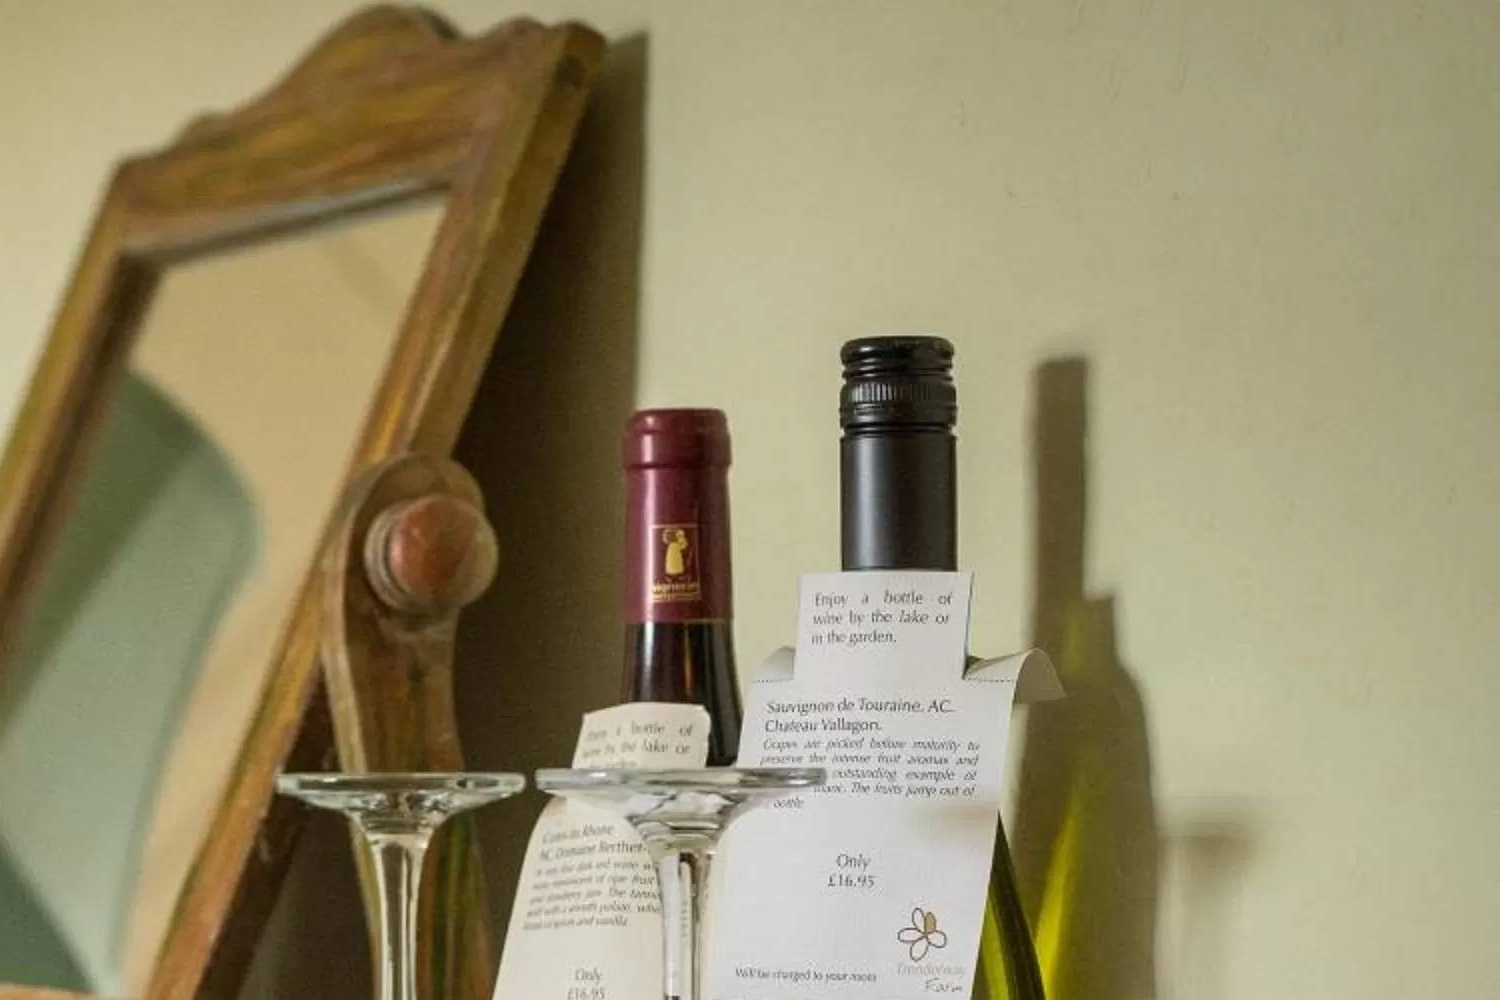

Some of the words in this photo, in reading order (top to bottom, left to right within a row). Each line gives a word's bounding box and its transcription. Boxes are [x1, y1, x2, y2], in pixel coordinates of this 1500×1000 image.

[815, 591, 848, 609] Enjoy
[860, 593, 869, 605] a
[884, 588, 924, 605] bottle
[937, 591, 955, 605] of
[813, 612, 843, 626] wine
[850, 609, 864, 627] by
[871, 610, 893, 624] the
[899, 610, 929, 625] lake
[935, 614, 950, 625] or
[811, 633, 823, 645] in
[827, 630, 845, 644] the
[849, 630, 898, 649] garden.
[767, 700, 834, 716] Sauvignon
[837, 697, 855, 712] de
[631, 720, 665, 735] bottle
[679, 723, 694, 737] of
[643, 740, 669, 753] lake
[824, 736, 866, 751] picked
[869, 736, 908, 750] before
[911, 739, 961, 753] maturity
[808, 752, 828, 764] the
[877, 753, 902, 765] fruit
[955, 754, 979, 767] and
[832, 767, 898, 783] outstanding
[905, 770, 956, 784] example
[963, 771, 978, 783] of
[851, 781, 871, 795] The
[874, 782, 903, 796] fruits
[905, 783, 938, 798] jump
[939, 784, 960, 796] out
[962, 782, 976, 797] of
[836, 853, 872, 871] Only
[827, 873, 877, 889] £16.95
[574, 967, 603, 985] Only
[772, 968, 811, 983] charged
